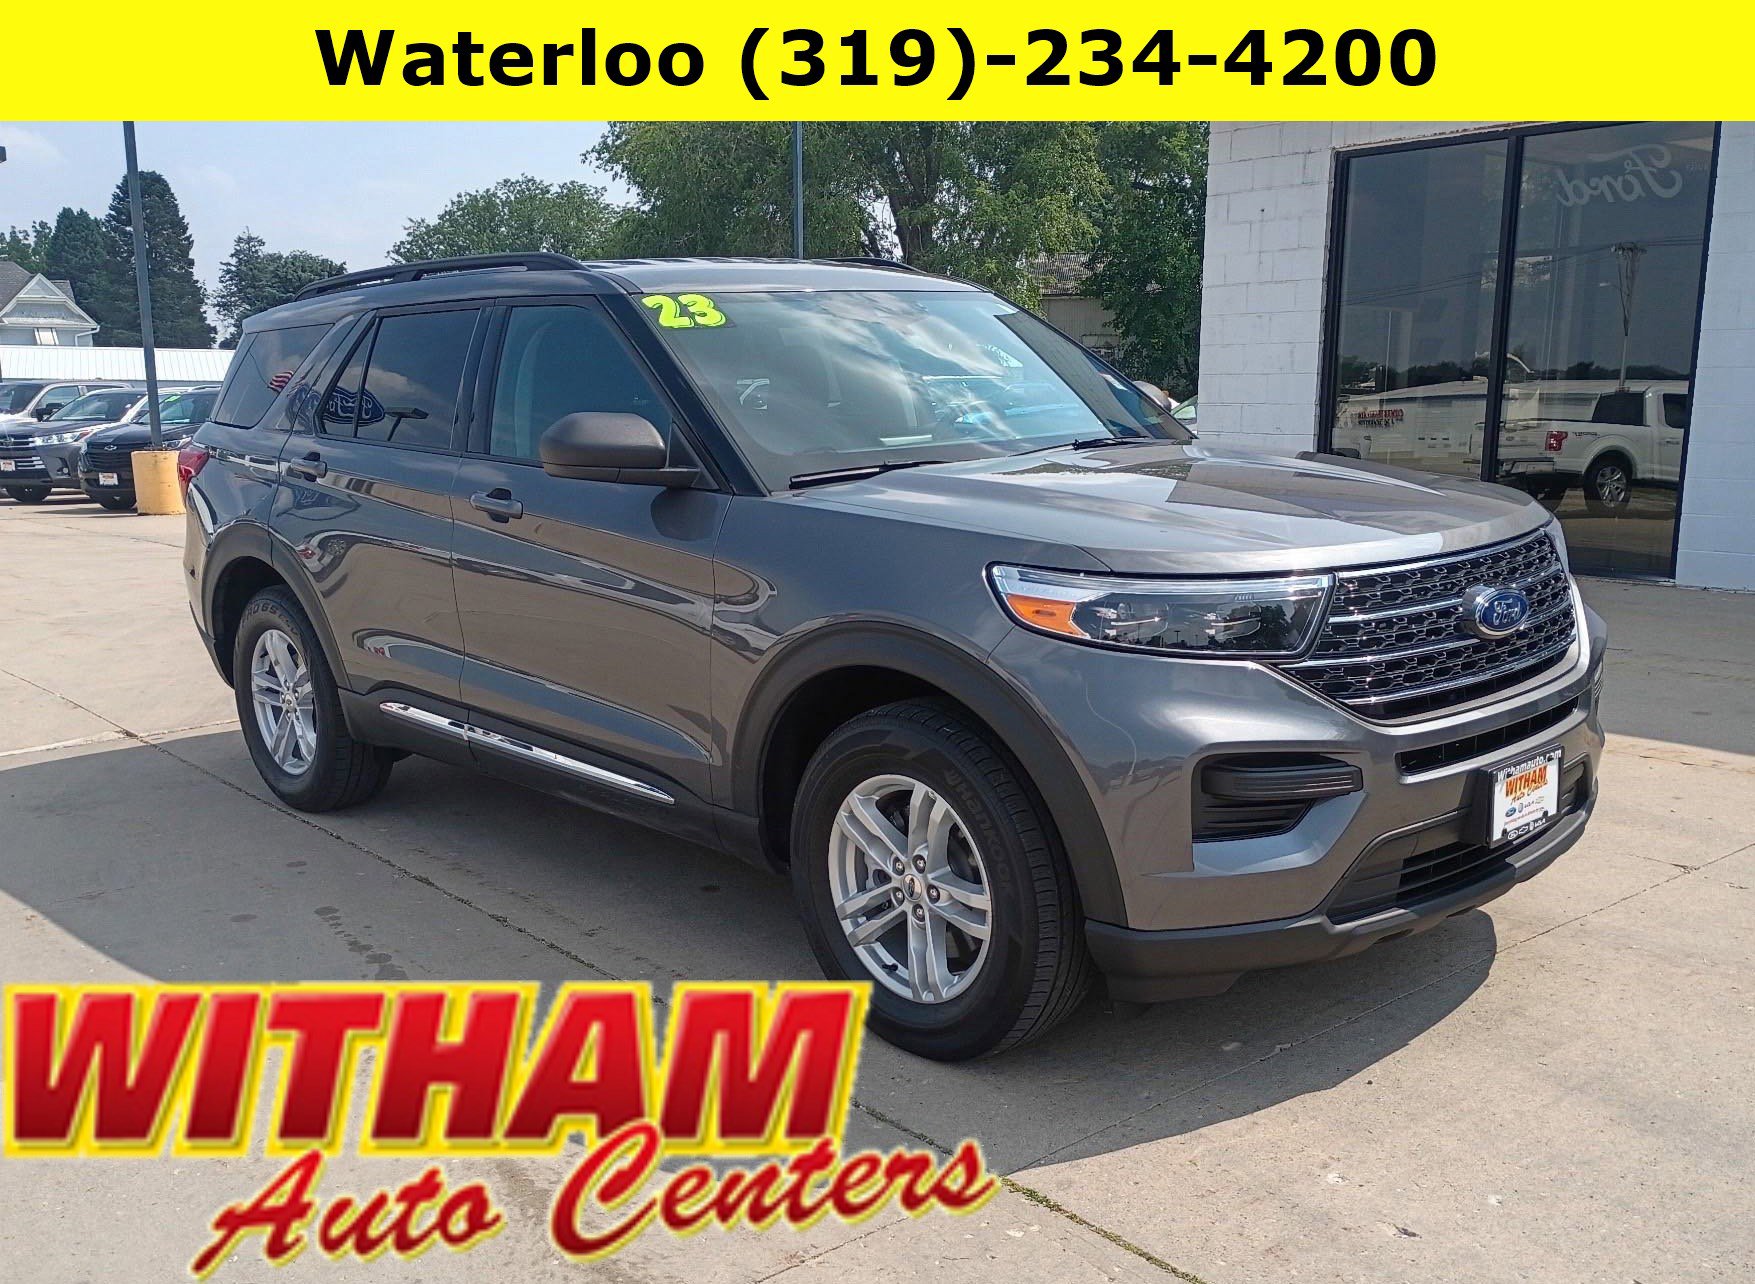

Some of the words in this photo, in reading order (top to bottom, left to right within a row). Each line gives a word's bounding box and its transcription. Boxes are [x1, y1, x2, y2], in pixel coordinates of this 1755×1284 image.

[641, 292, 727, 328] 23
[1493, 597, 1521, 627] Ford
[1505, 765, 1547, 798] WITHAM
